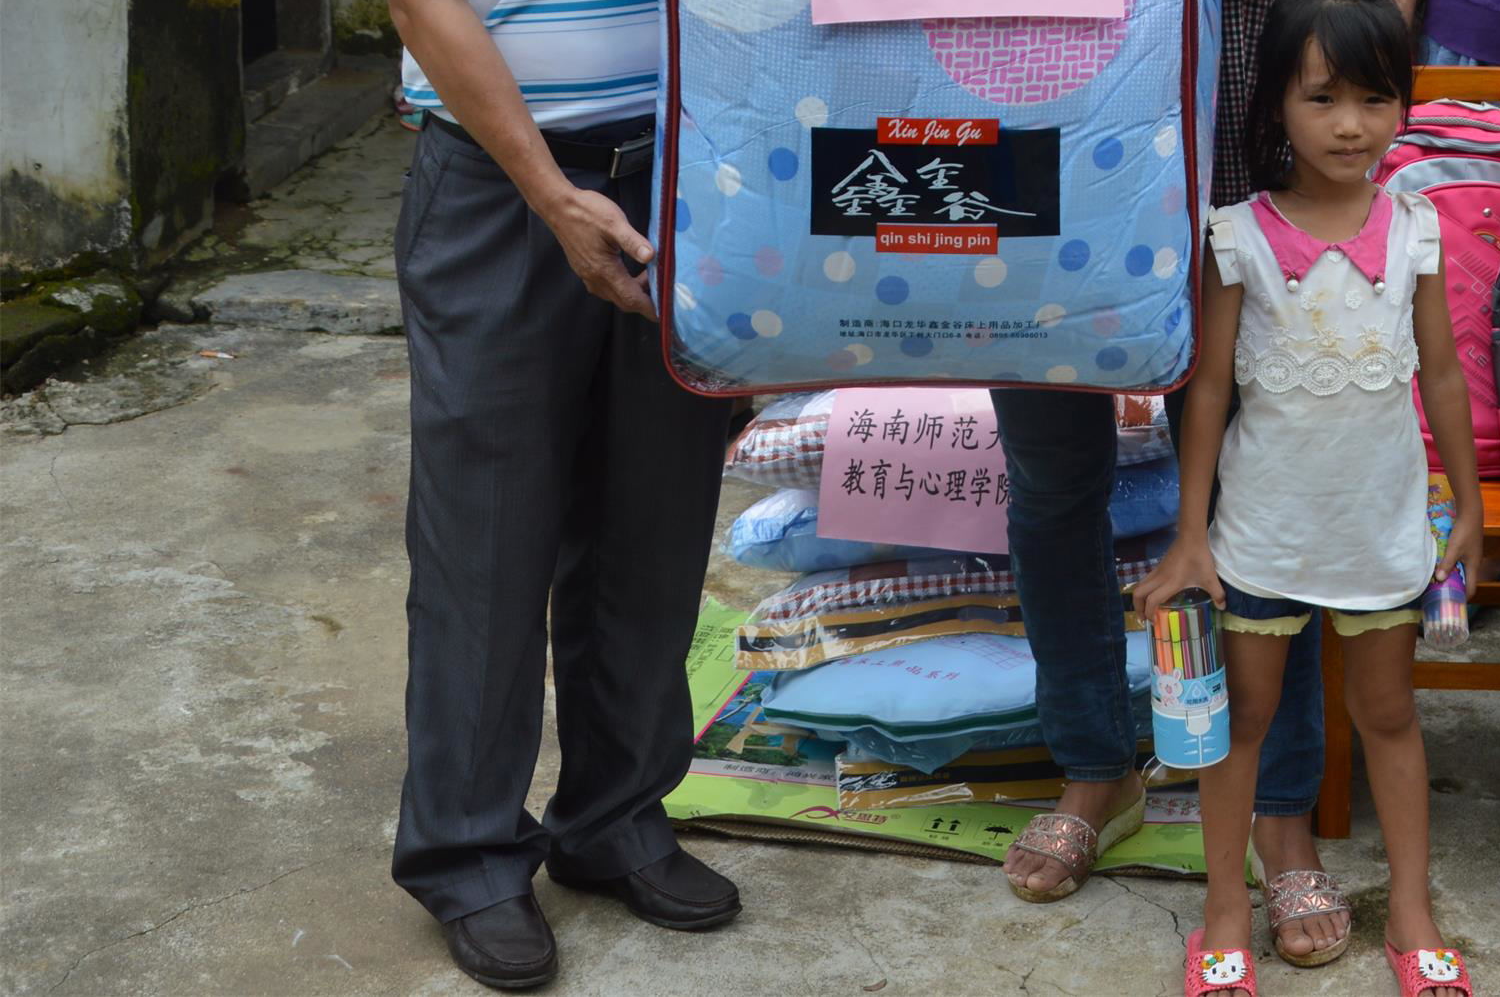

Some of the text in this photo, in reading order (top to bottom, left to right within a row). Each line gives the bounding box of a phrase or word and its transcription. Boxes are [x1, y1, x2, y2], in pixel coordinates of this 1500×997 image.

[887, 119, 983, 147] Xin Jin Gu
[880, 232, 991, 250] qin shi jing pin
